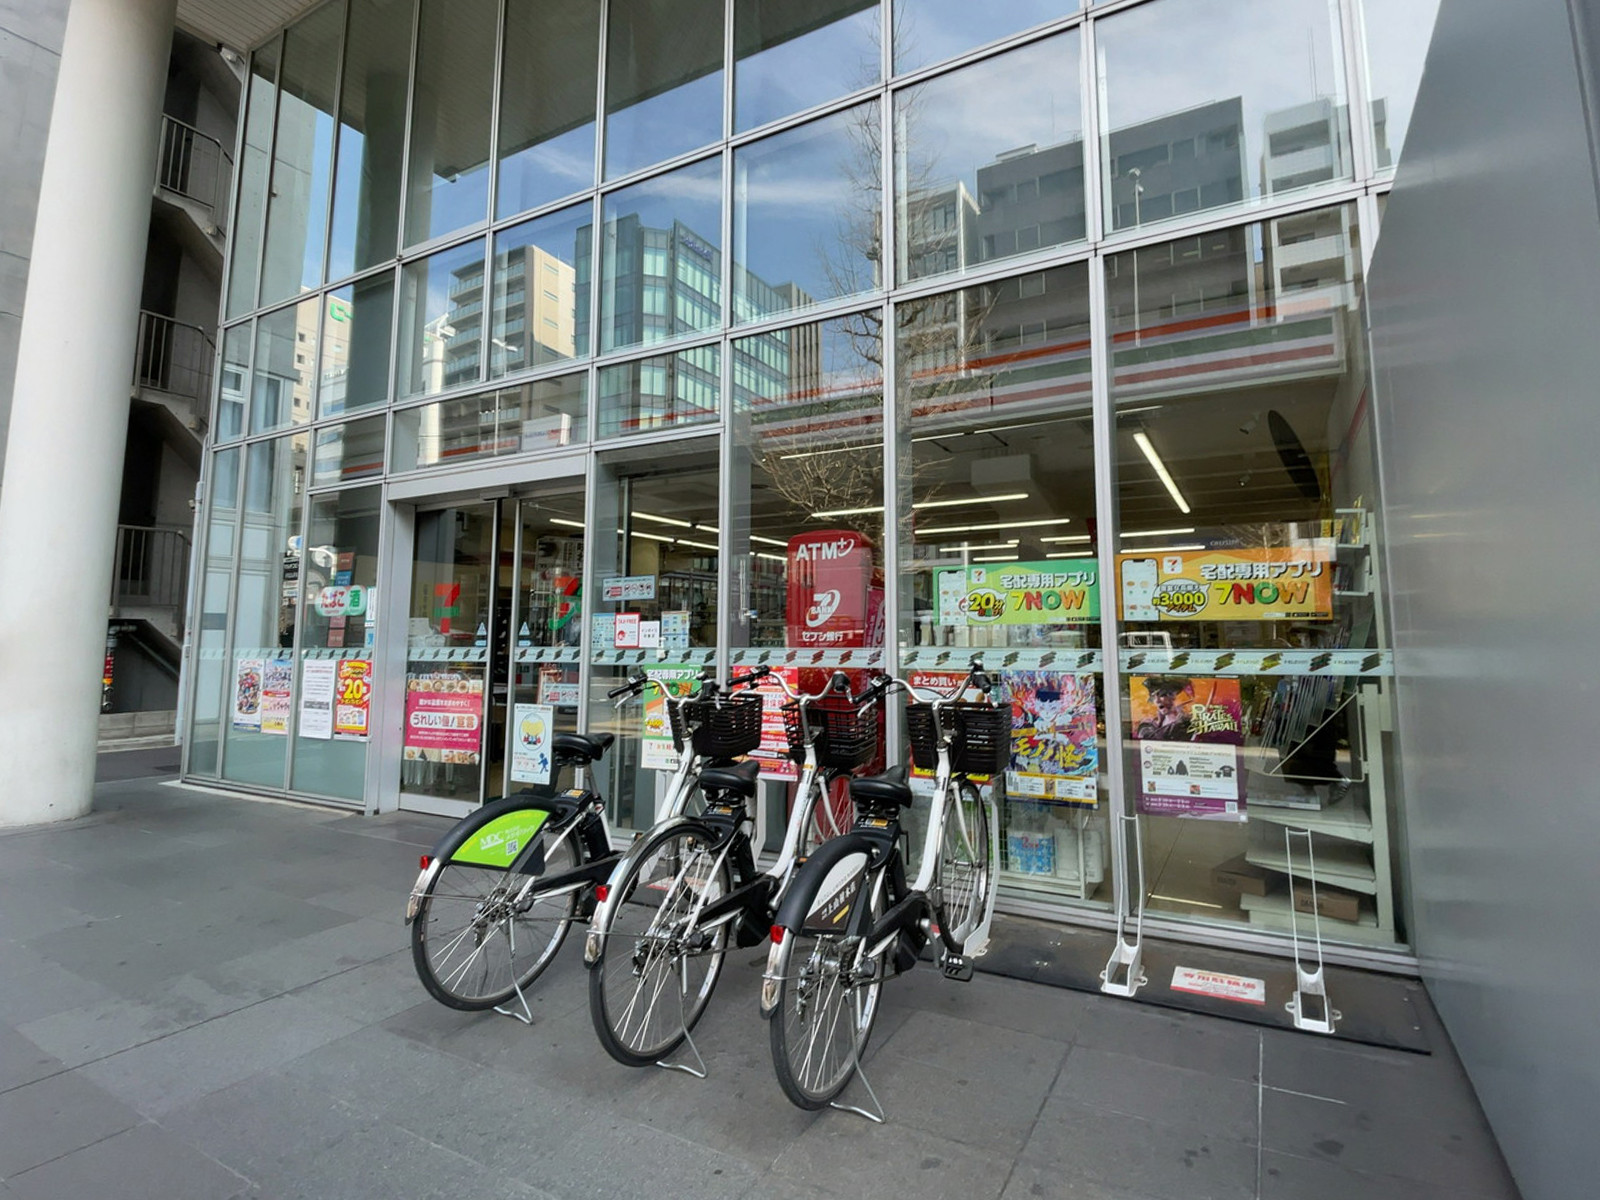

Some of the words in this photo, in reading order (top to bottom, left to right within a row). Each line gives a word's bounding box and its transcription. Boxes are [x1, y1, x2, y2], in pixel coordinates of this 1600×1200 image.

[796, 541, 839, 561] ATM
[999, 571, 1096, 589] 宅配専用アプリ
[1200, 560, 1323, 582] 宅配専用アプリ
[1011, 589, 1086, 611] 7NOW
[1214, 581, 1309, 605] 7NOW
[802, 631, 843, 641] セブン銀行
[344, 678, 364, 699] 20
